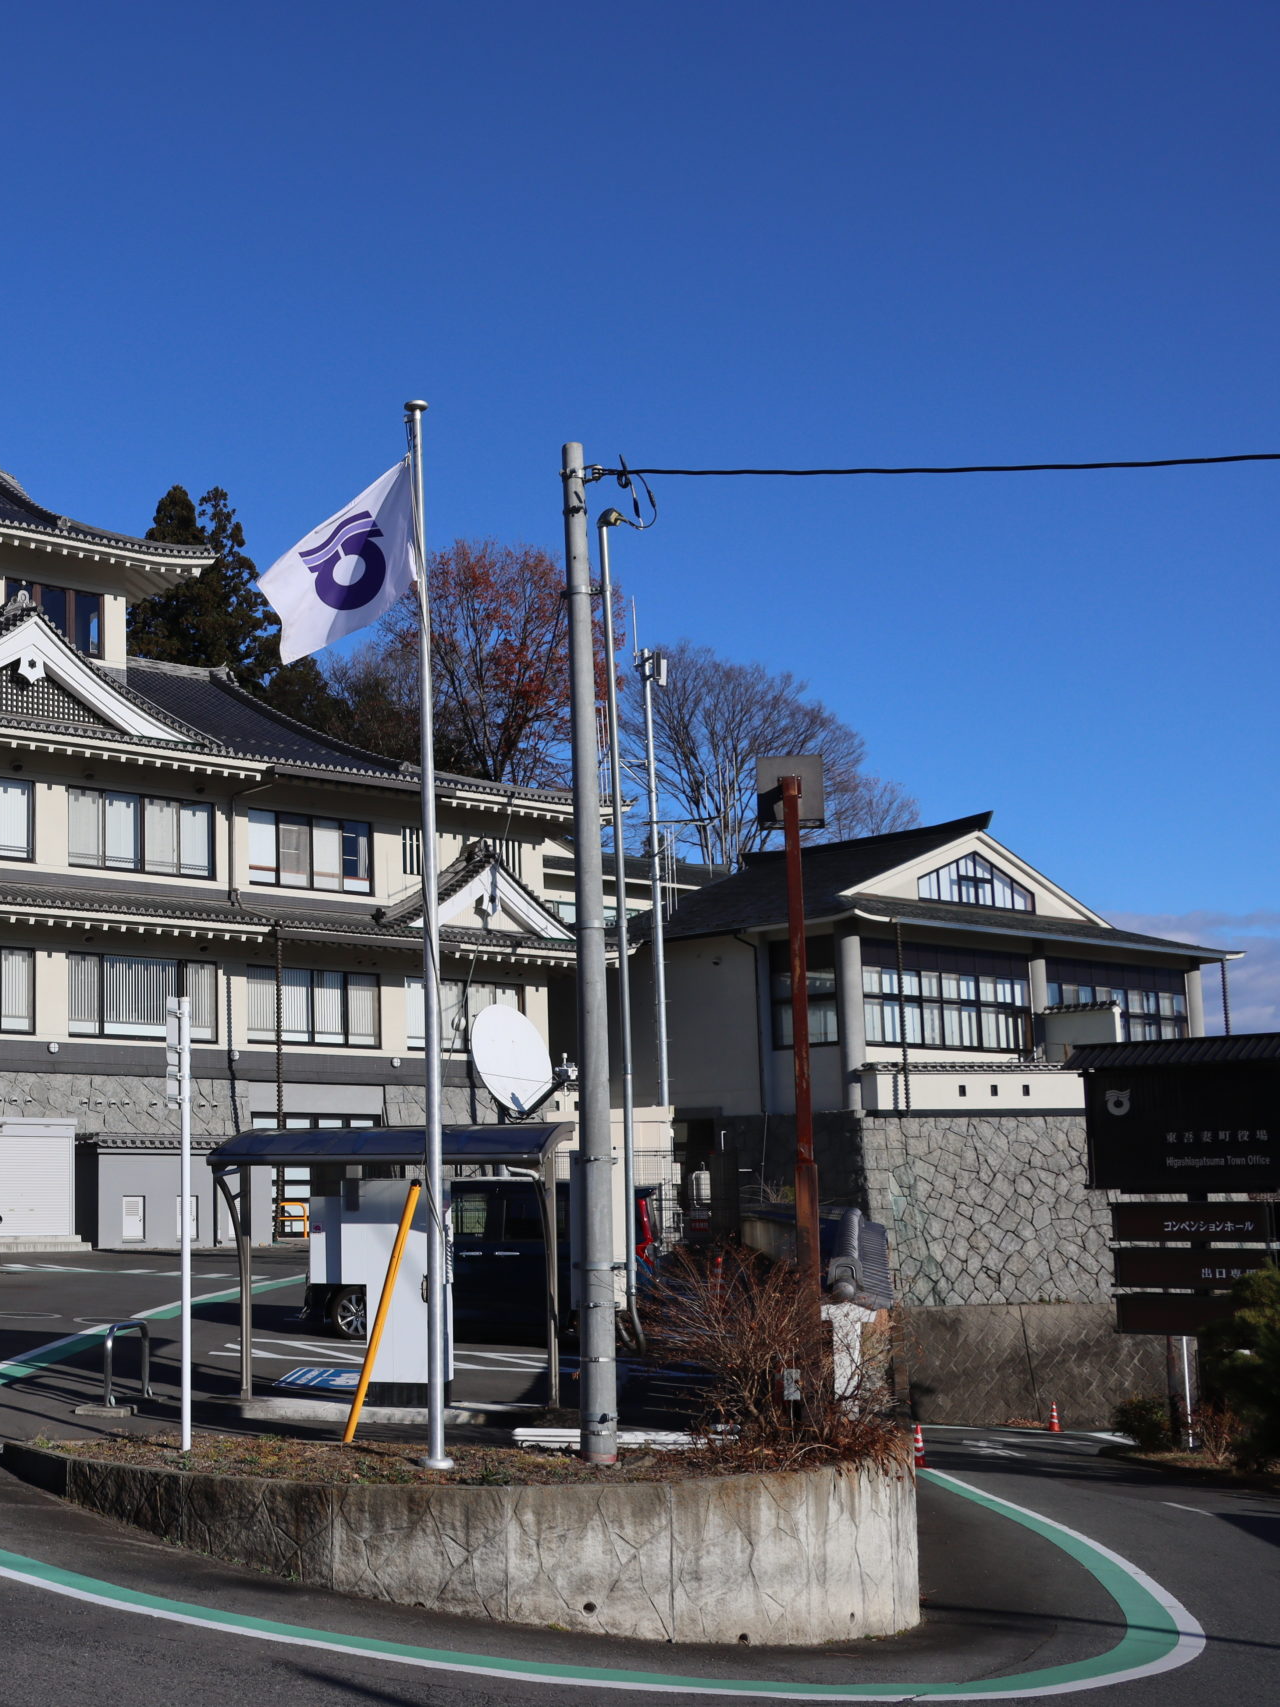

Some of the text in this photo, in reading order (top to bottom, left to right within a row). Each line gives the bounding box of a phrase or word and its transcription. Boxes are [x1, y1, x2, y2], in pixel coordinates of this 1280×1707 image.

[1166, 1130, 1269, 1143] 東吾妻町役場
[1166, 1155, 1270, 1168] Higashiagatsuma Town Office
